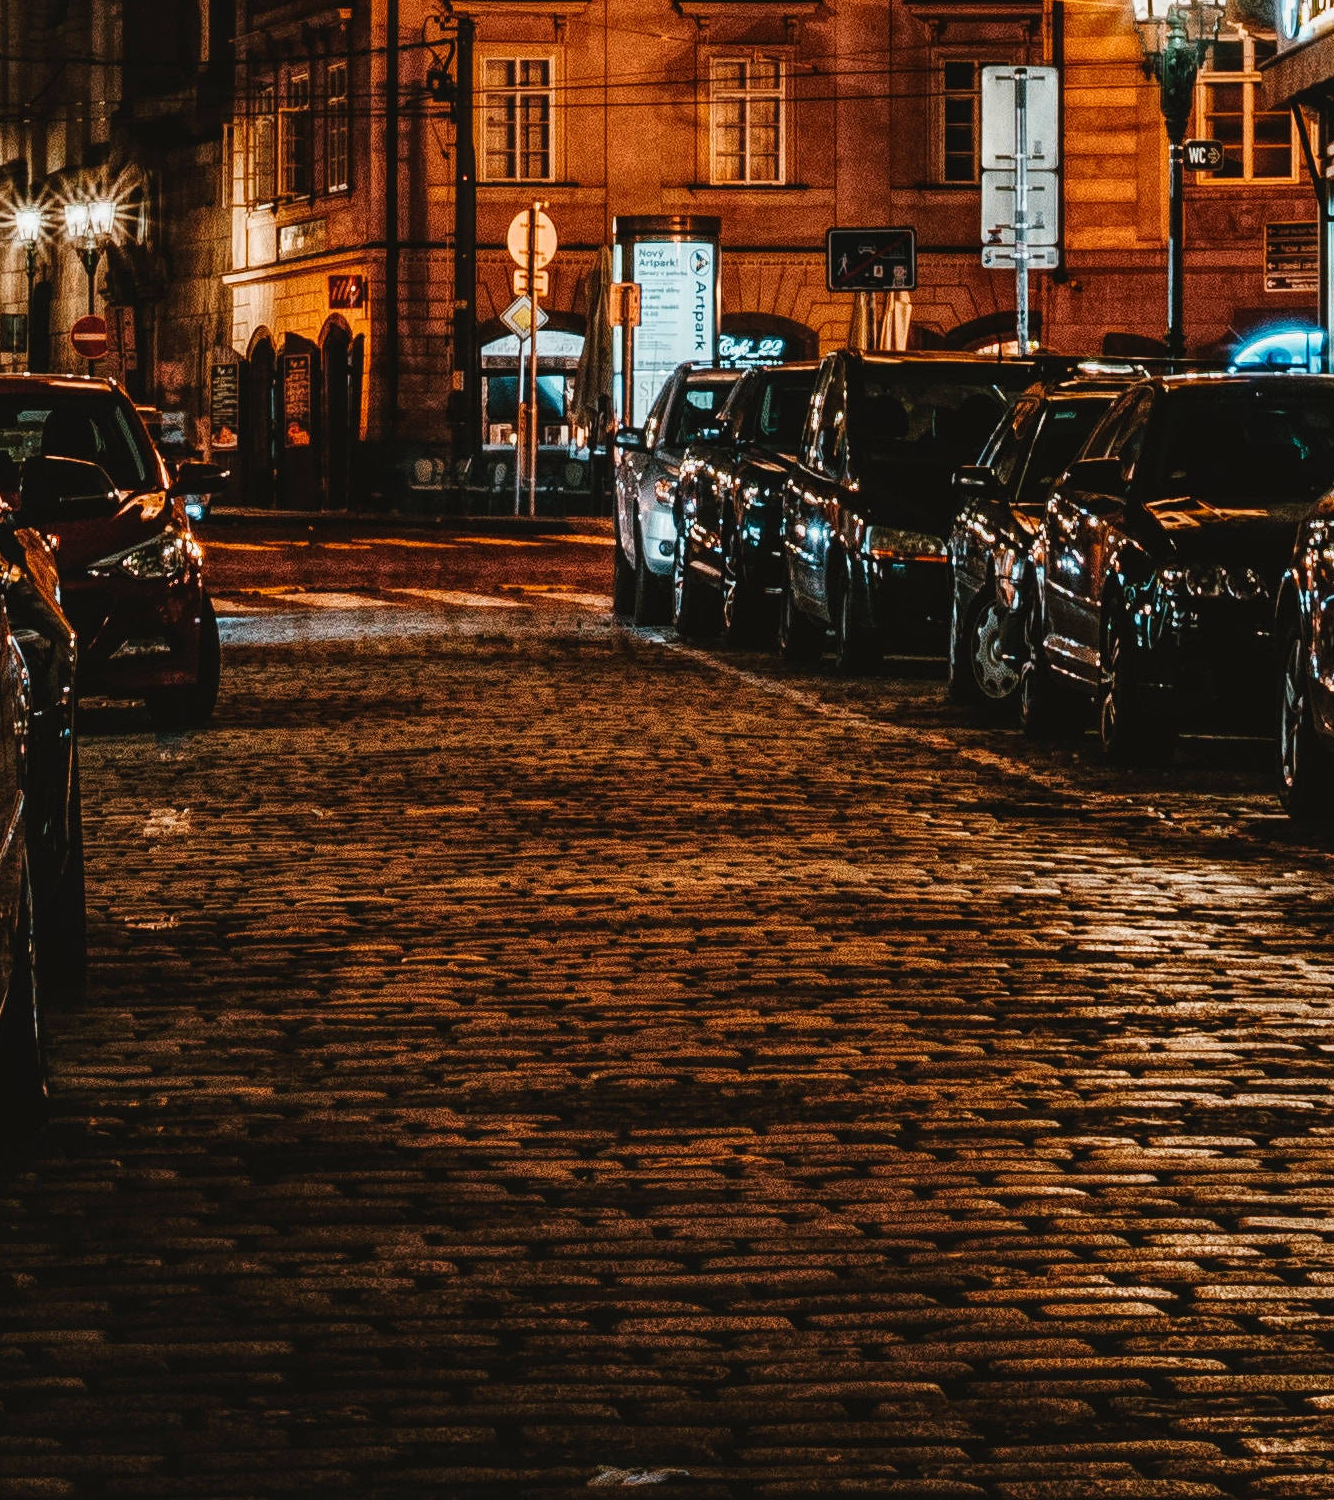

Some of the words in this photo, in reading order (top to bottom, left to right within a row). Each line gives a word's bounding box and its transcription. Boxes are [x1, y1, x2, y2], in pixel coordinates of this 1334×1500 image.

[1188, 146, 1207, 164] WC
[639, 248, 664, 258] Nový
[639, 258, 679, 268] Artpark!
[693, 281, 707, 350] Artpark
